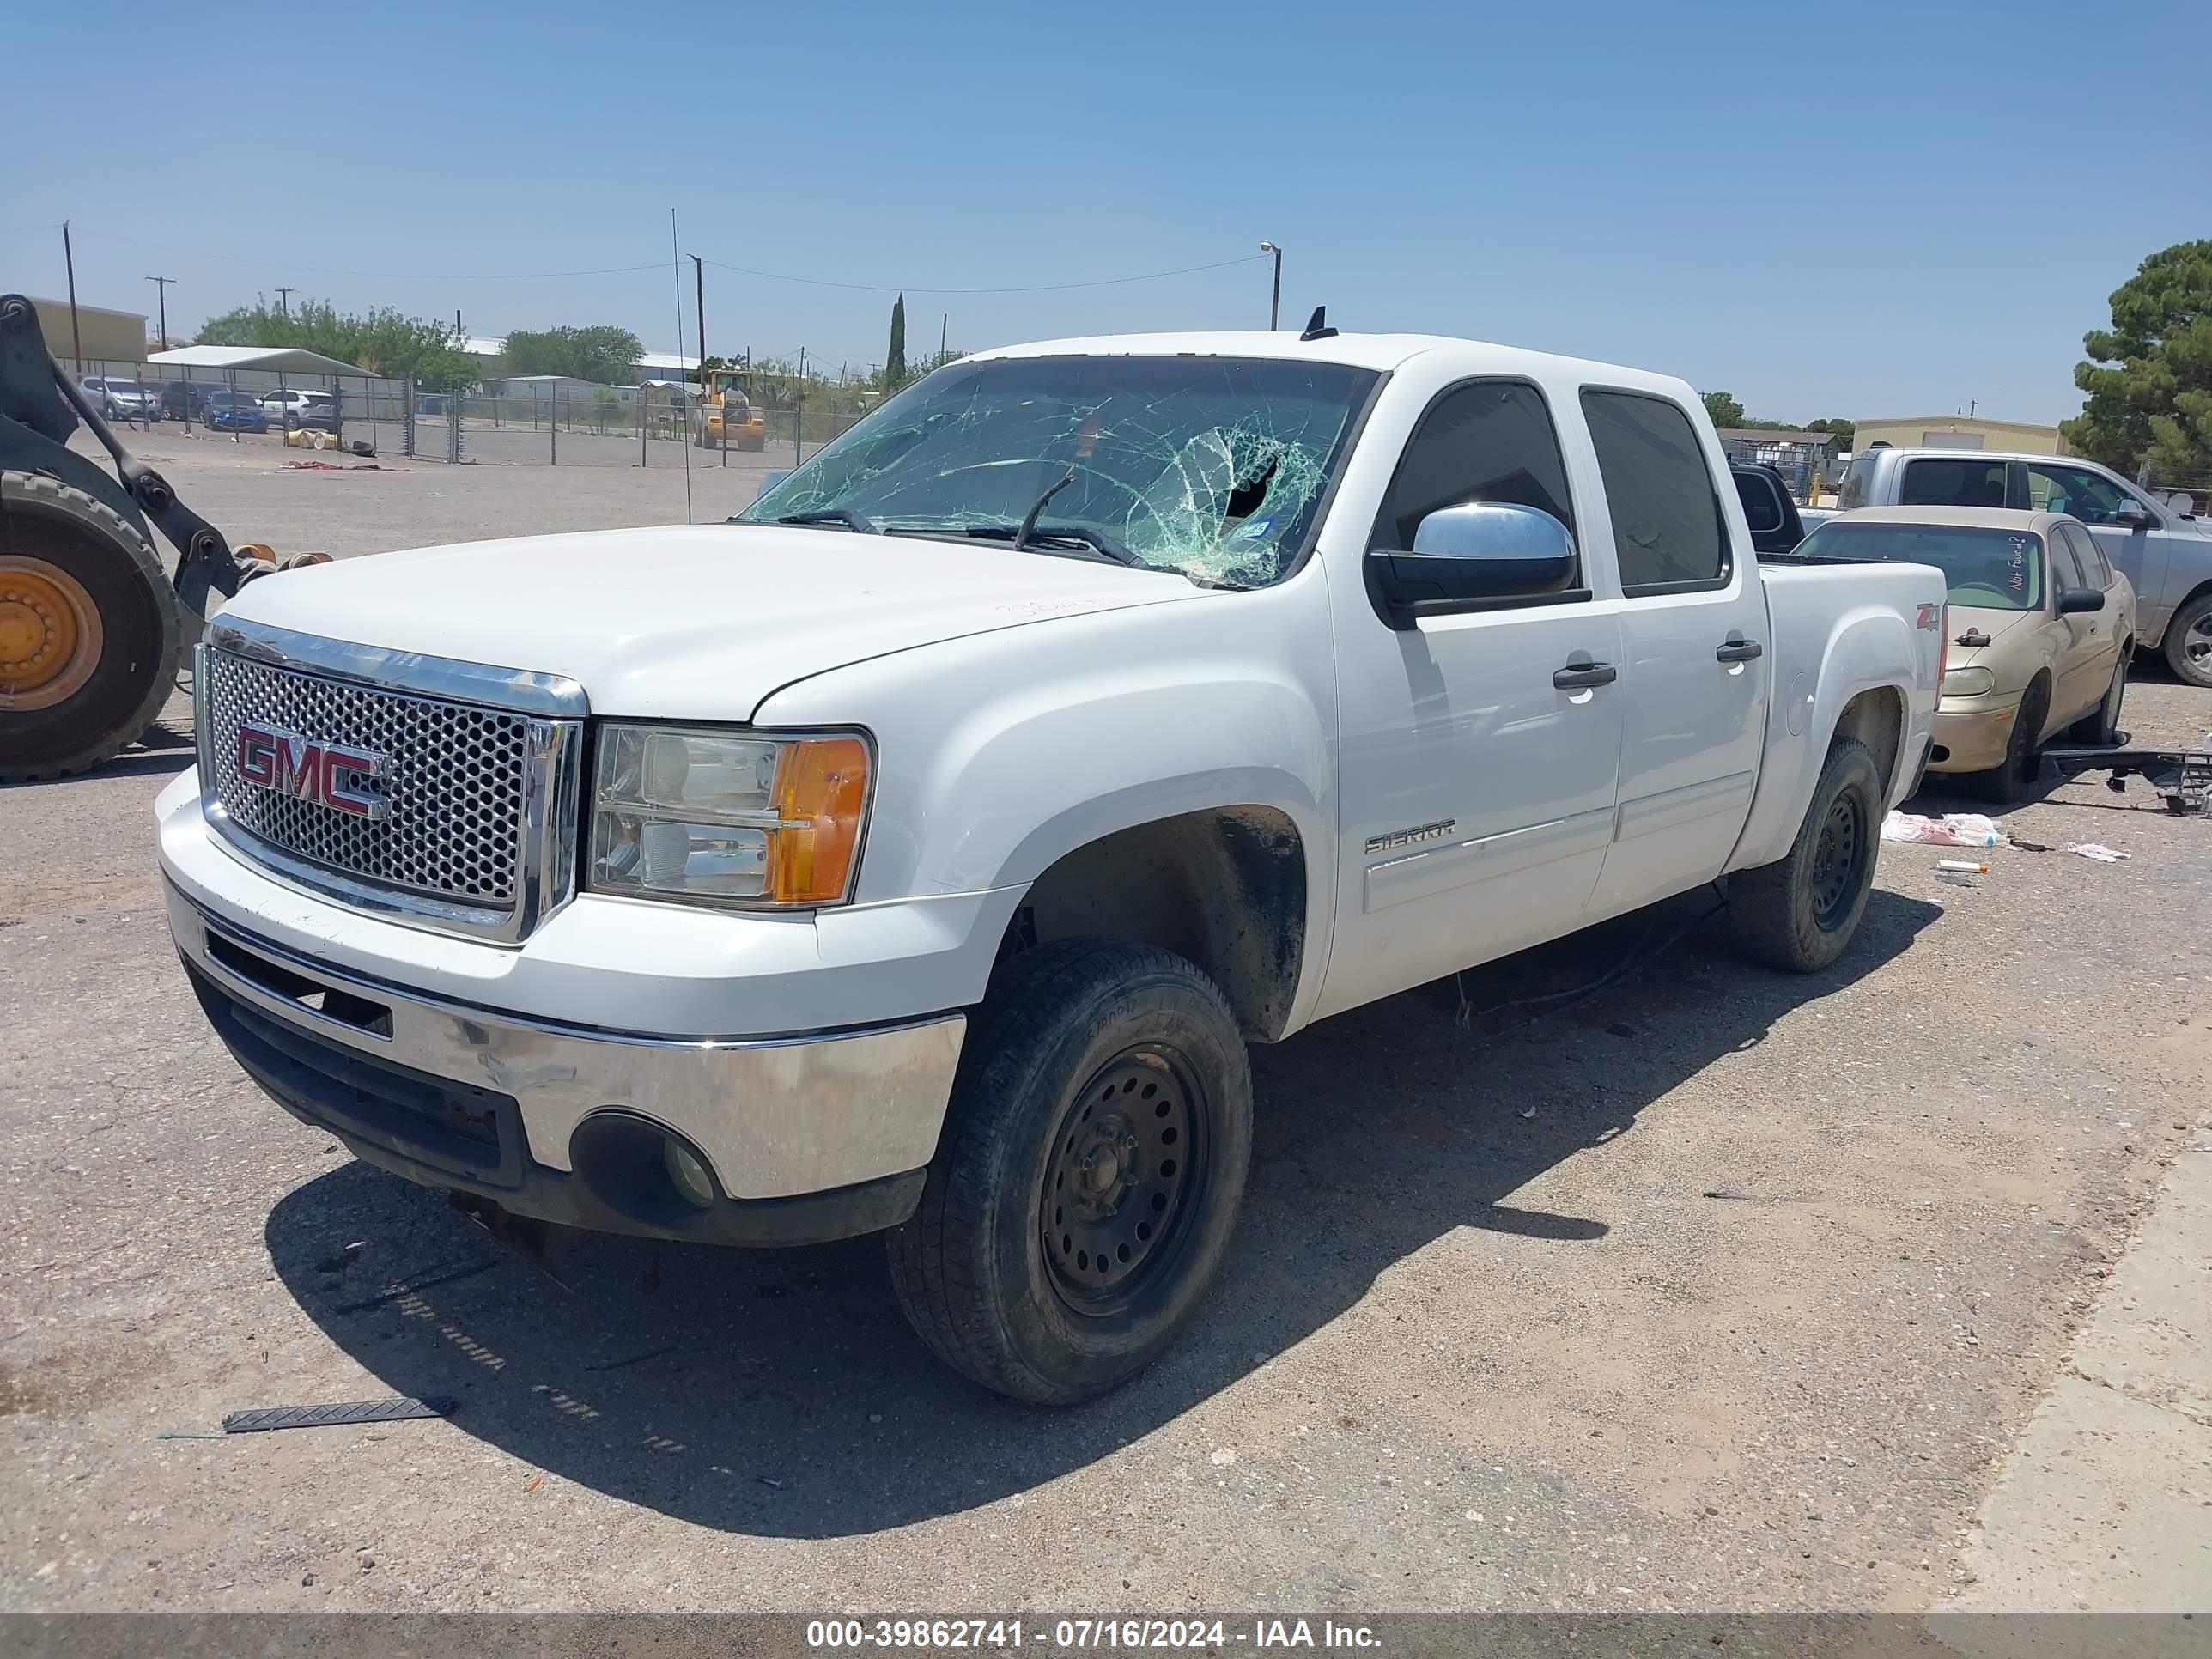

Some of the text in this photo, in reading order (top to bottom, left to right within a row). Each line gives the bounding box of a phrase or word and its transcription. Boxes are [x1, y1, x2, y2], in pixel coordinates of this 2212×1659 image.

[2008, 572, 2023, 591] Not
[238, 725, 386, 821] GMC
[1364, 818, 1456, 854] SIERRA
